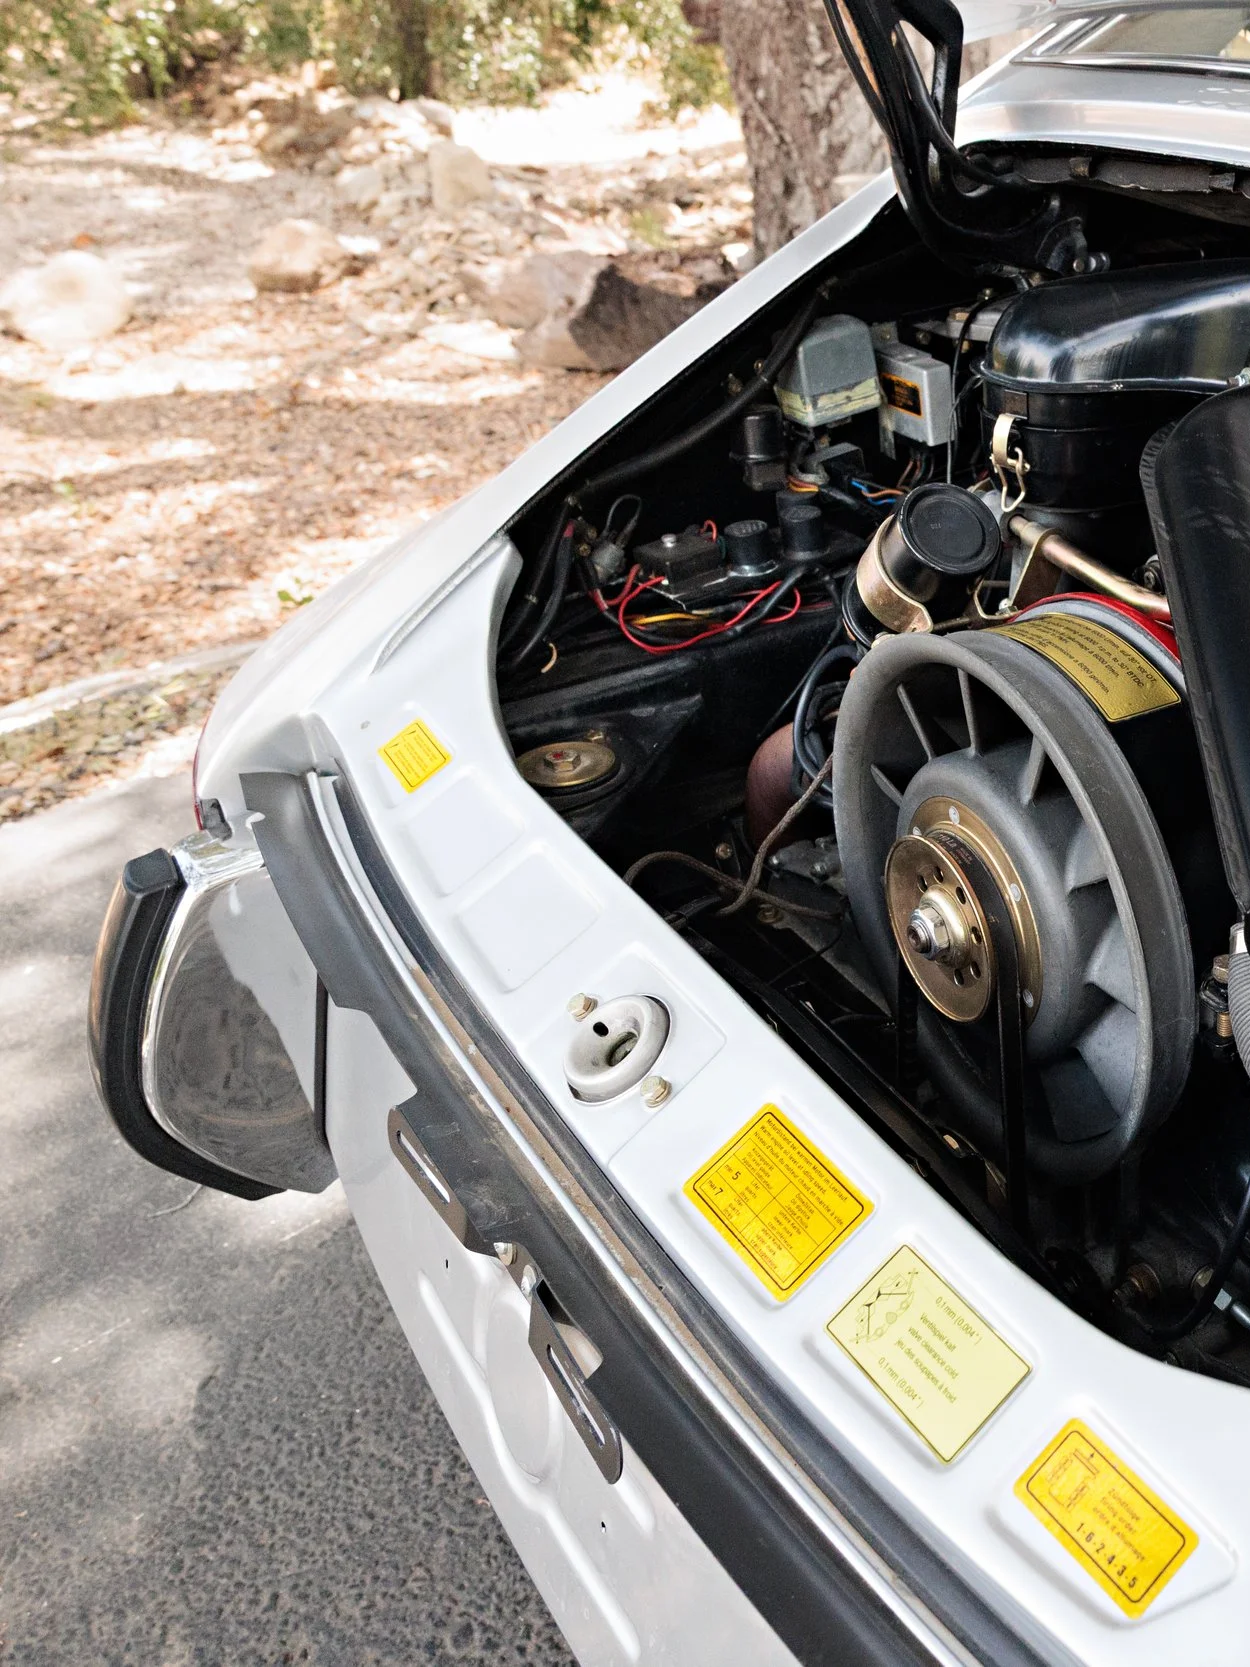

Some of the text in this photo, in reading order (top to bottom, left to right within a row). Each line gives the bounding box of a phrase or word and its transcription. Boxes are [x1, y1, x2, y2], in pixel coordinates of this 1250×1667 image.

[752, 1131, 767, 1146] Niveau
[777, 1157, 785, 1165] du
[783, 1163, 798, 1179] moteur
[797, 1177, 811, 1191] chaud
[814, 1195, 831, 1213] marche
[759, 1125, 772, 1137] Warm
[769, 1136, 783, 1151] engine
[787, 1154, 798, 1165] level
[801, 1168, 814, 1182] idling
[789, 1142, 798, 1151] bei
[810, 1164, 825, 1179] Motor
[822, 1176, 831, 1185] im
[713, 1187, 723, 1197] 7
[731, 1170, 741, 1181] 5
[942, 1304, 957, 1319] mm
[908, 1325, 959, 1379] valve clearance cold
[918, 1313, 957, 1352] Ventilspiel kalt
[885, 1366, 899, 1381] mm
[894, 1337, 907, 1351] jeu
[903, 1346, 916, 1360] des
[911, 1357, 939, 1387] soupapes
[941, 1386, 957, 1404] froid
